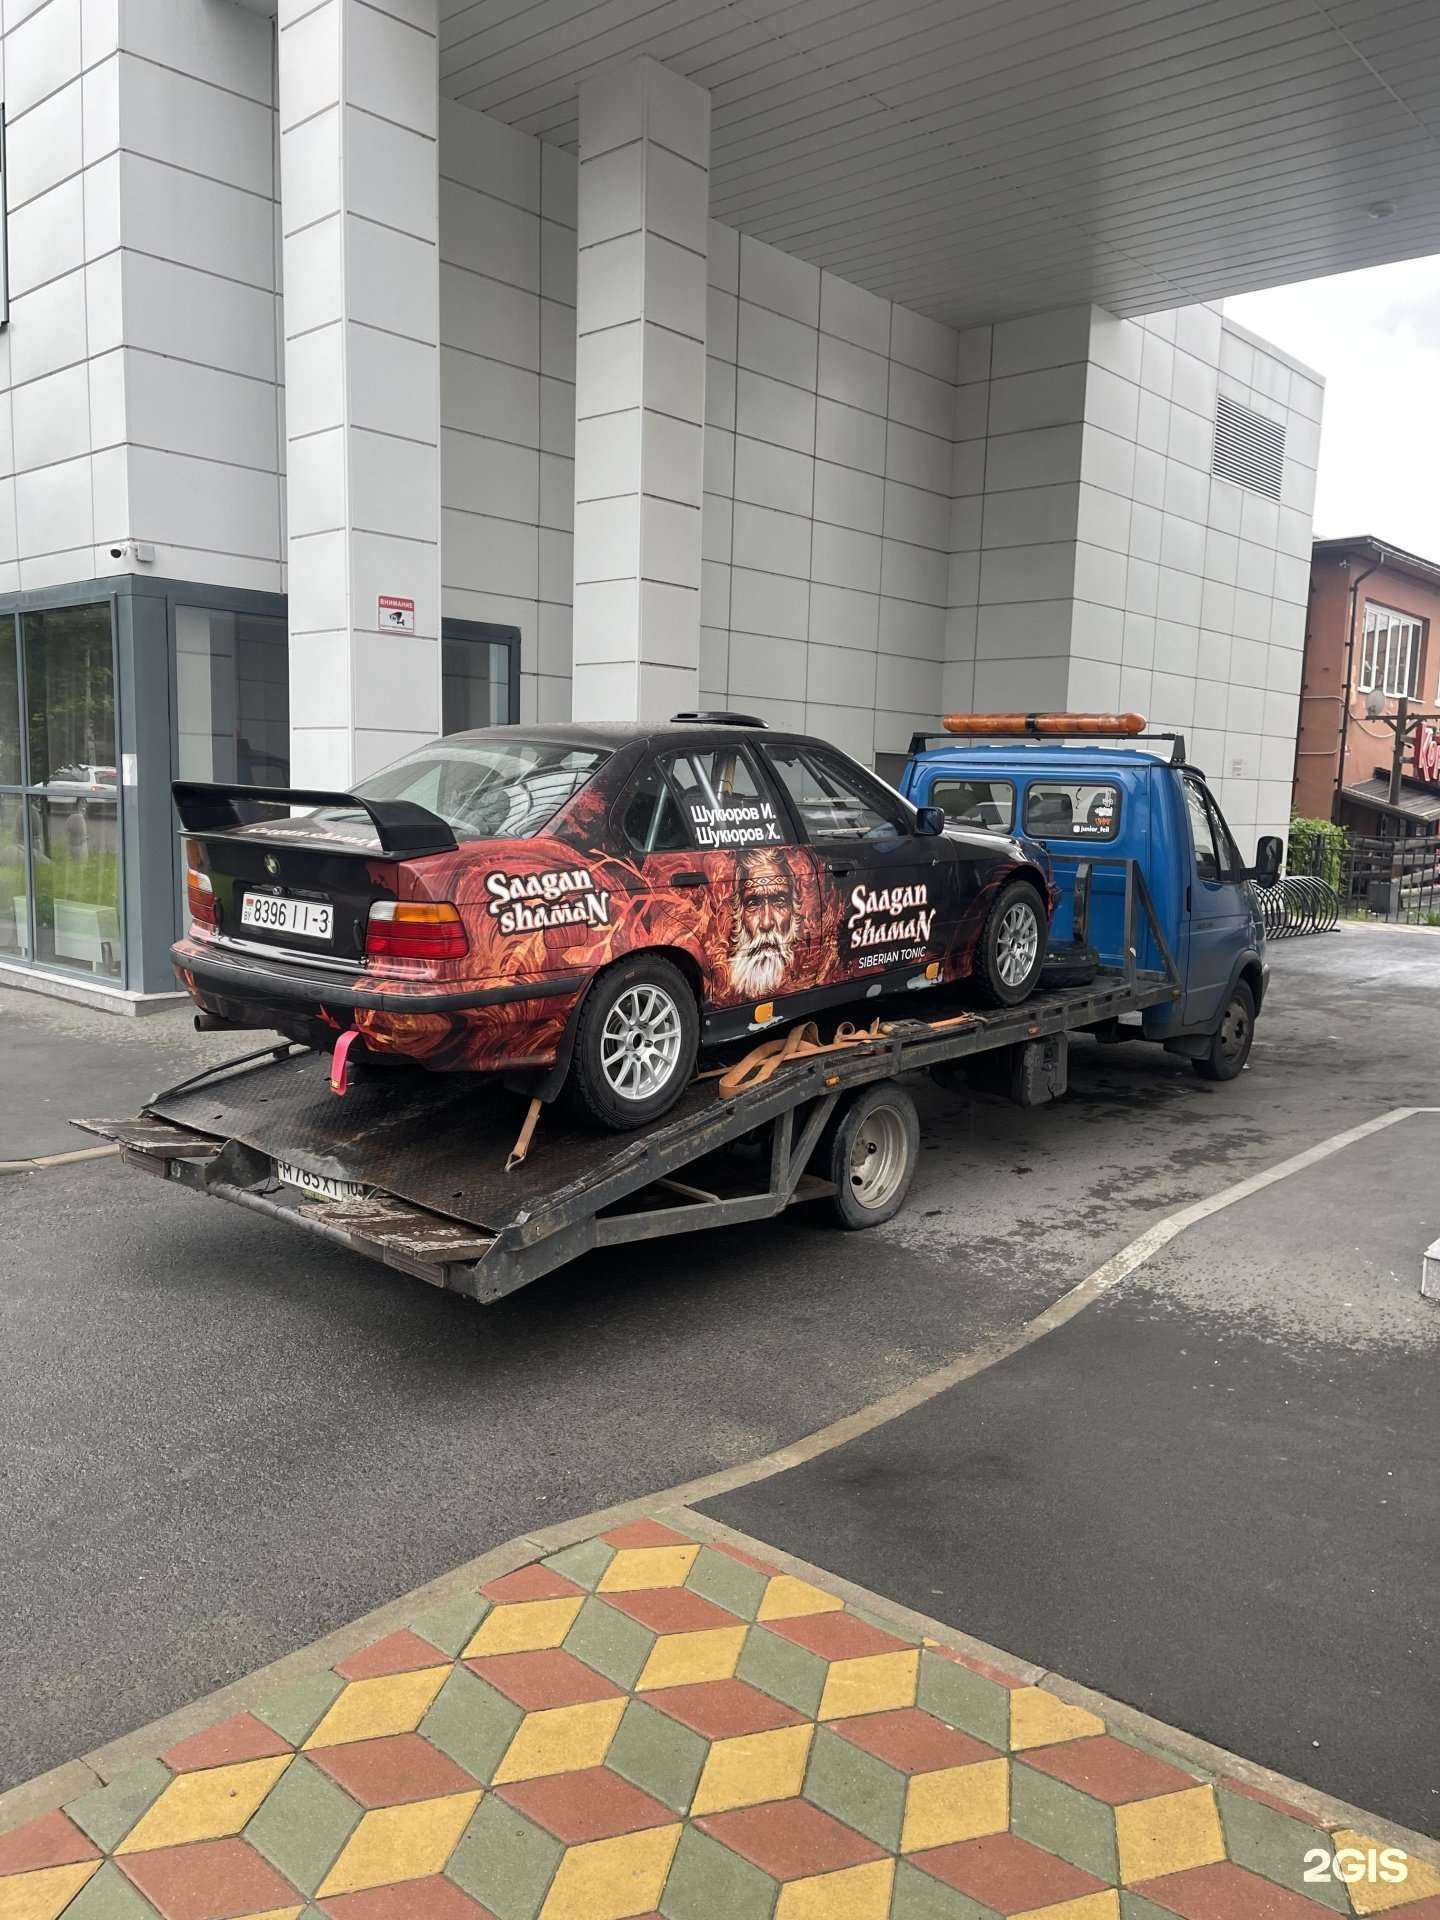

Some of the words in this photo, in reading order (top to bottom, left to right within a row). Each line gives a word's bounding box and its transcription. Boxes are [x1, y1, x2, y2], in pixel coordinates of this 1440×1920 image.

[690, 805, 760, 826] Шукюров
[760, 803, 777, 820] И.
[695, 826, 764, 848] Шукюров
[765, 823, 781, 840] Х.
[486, 869, 594, 914] Saagan
[254, 899, 287, 926] 8396
[847, 883, 928, 930] Saagan
[858, 950, 899, 969] SIBERIAN
[900, 945, 927, 961] TONIC
